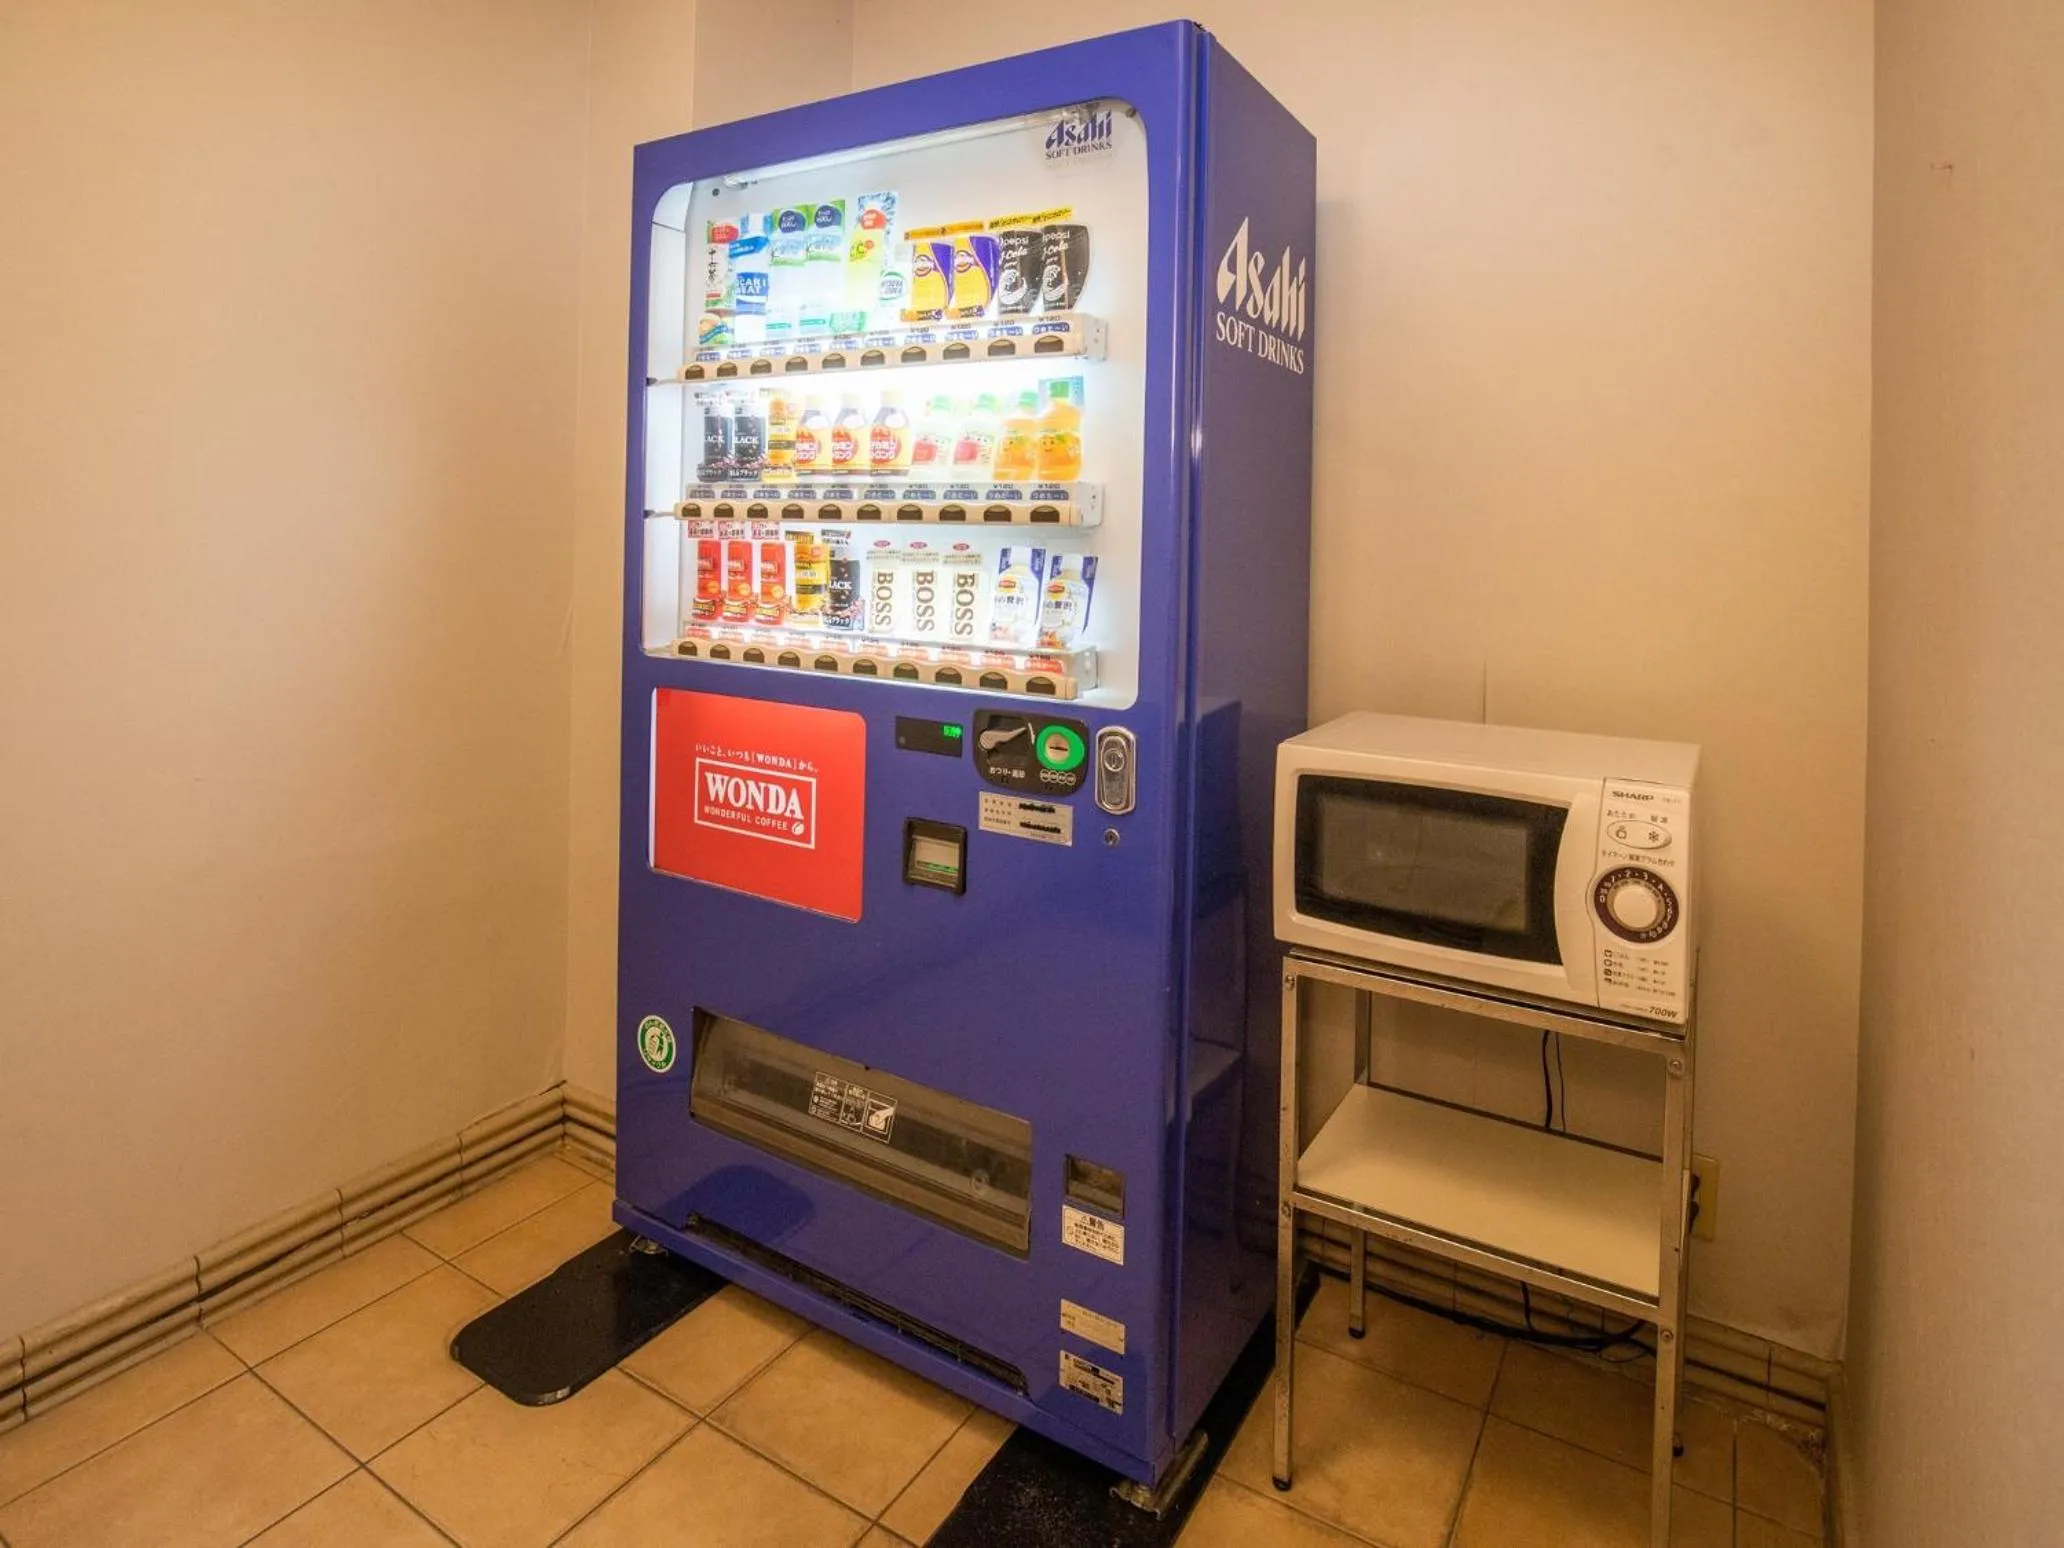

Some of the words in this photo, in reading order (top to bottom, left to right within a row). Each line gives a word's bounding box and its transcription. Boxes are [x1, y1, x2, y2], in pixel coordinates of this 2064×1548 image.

[1045, 109, 1112, 149] Asahi
[1045, 146, 1070, 160] SOFT
[1073, 142, 1113, 156] DRINKS
[1216, 216, 1306, 342] Asahi
[1215, 311, 1257, 353] SOFT
[1257, 330, 1304, 375] DRINKS
[734, 435, 759, 445] LACK
[829, 580, 852, 590] LACK
[875, 571, 894, 626] BOSS
[916, 571, 935, 632] BOSS
[954, 573, 975, 636] BOSS
[704, 771, 805, 820] WONDA
[1612, 790, 1655, 801] SHARP
[704, 805, 752, 824] WONDERFUL
[755, 815, 789, 831] COFFEE
[1649, 1006, 1678, 1018] 700W
